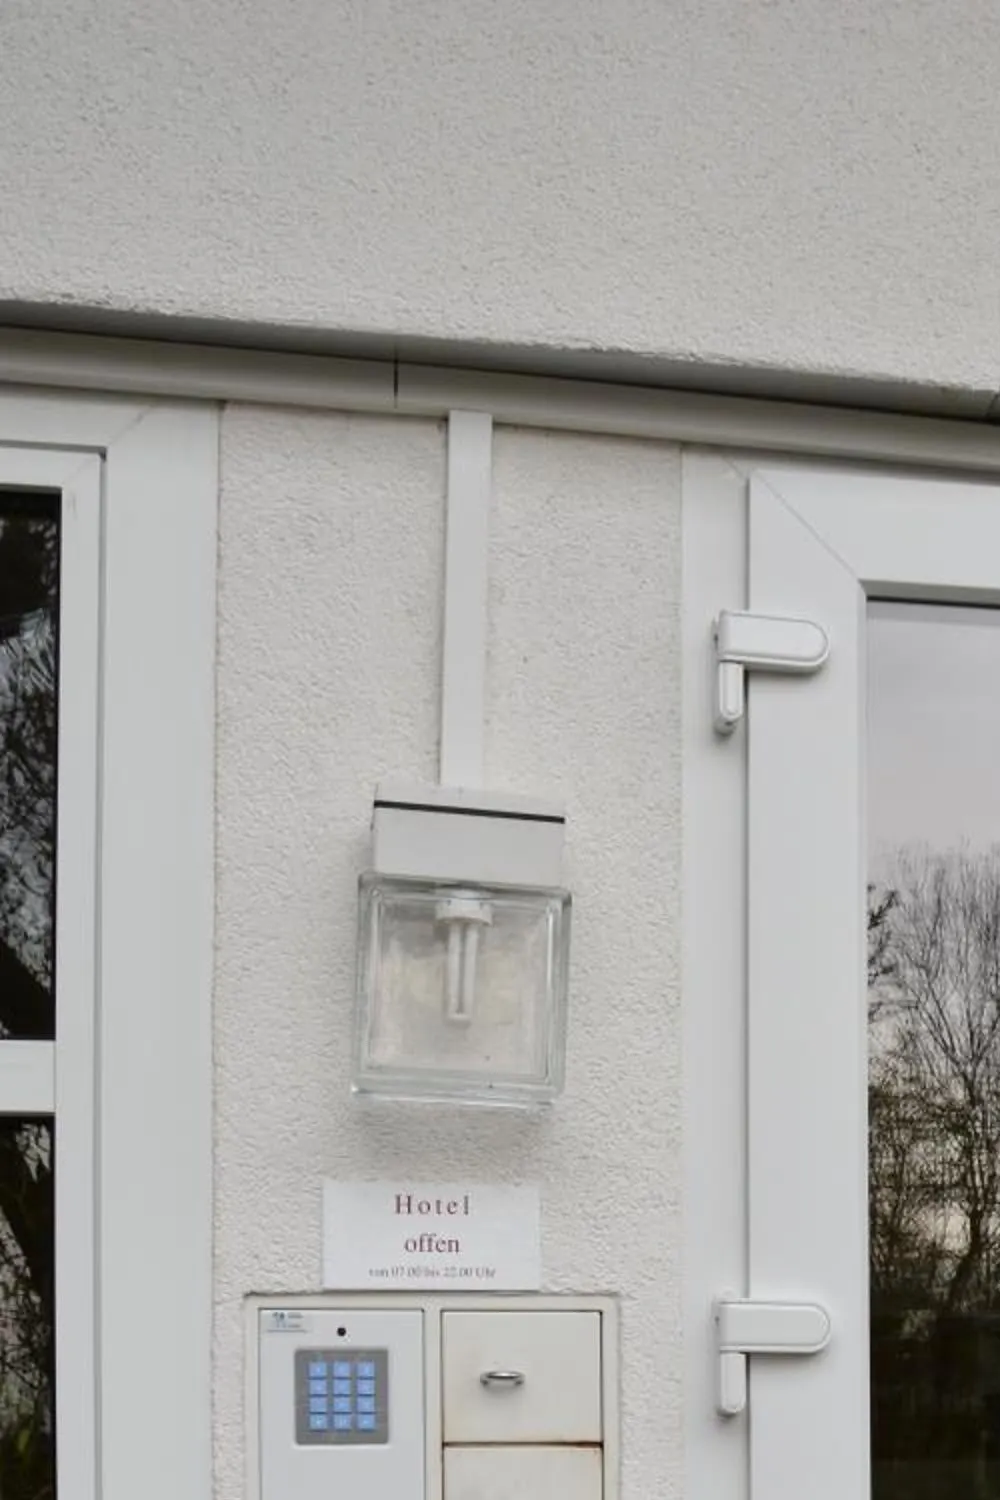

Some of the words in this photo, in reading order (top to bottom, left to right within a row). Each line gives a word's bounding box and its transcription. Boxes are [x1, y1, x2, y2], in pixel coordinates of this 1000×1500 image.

[393, 1194, 469, 1215] Hotel
[404, 1232, 460, 1253] offen
[368, 1268, 389, 1278] von
[424, 1266, 440, 1278] bis
[475, 1266, 496, 1279] Uhr
